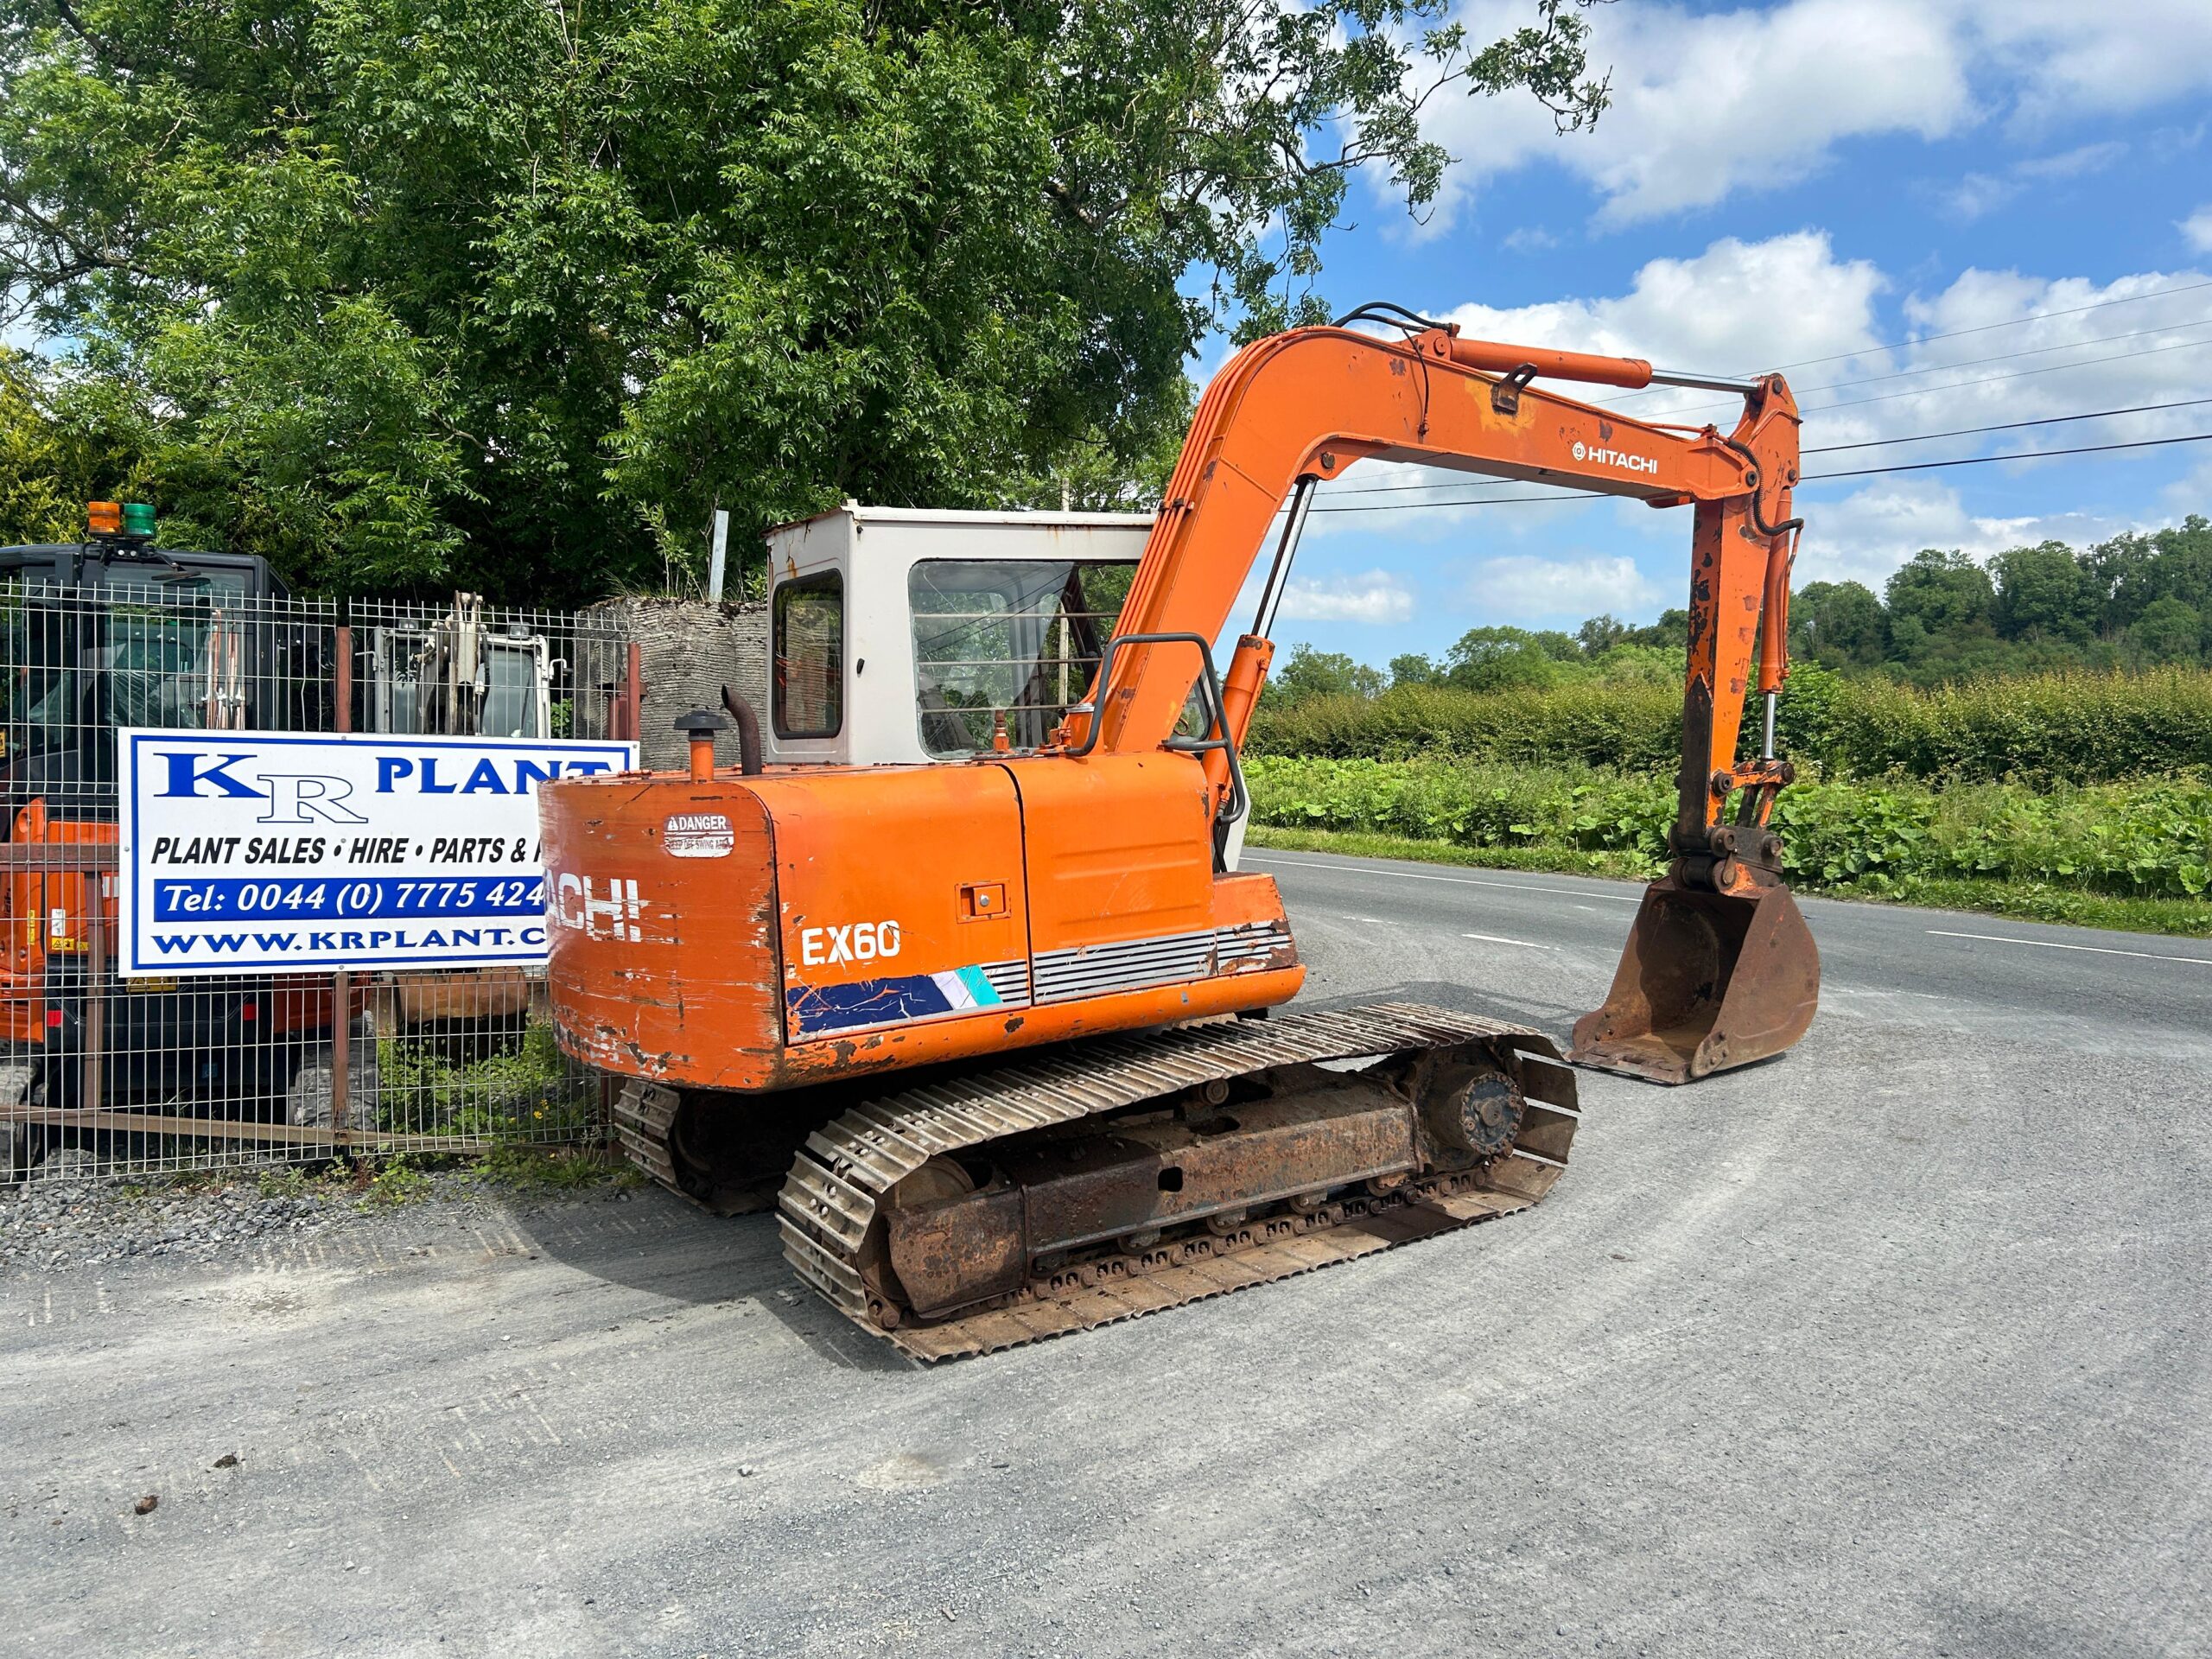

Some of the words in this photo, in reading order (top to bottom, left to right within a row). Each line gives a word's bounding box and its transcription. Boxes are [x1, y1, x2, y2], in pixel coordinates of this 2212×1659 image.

[1588, 446, 1657, 474] HITACHI
[678, 815, 727, 830] DANGER
[150, 837, 241, 864] PLANT
[245, 837, 326, 864] SALES
[348, 837, 409, 863] HIRE
[429, 837, 505, 863] PARTS
[510, 837, 526, 863] &
[163, 884, 226, 912] Tel:
[238, 883, 327, 911] 0044
[336, 883, 383, 916] (0)
[397, 882, 477, 907] 7775
[802, 919, 900, 966] EX60
